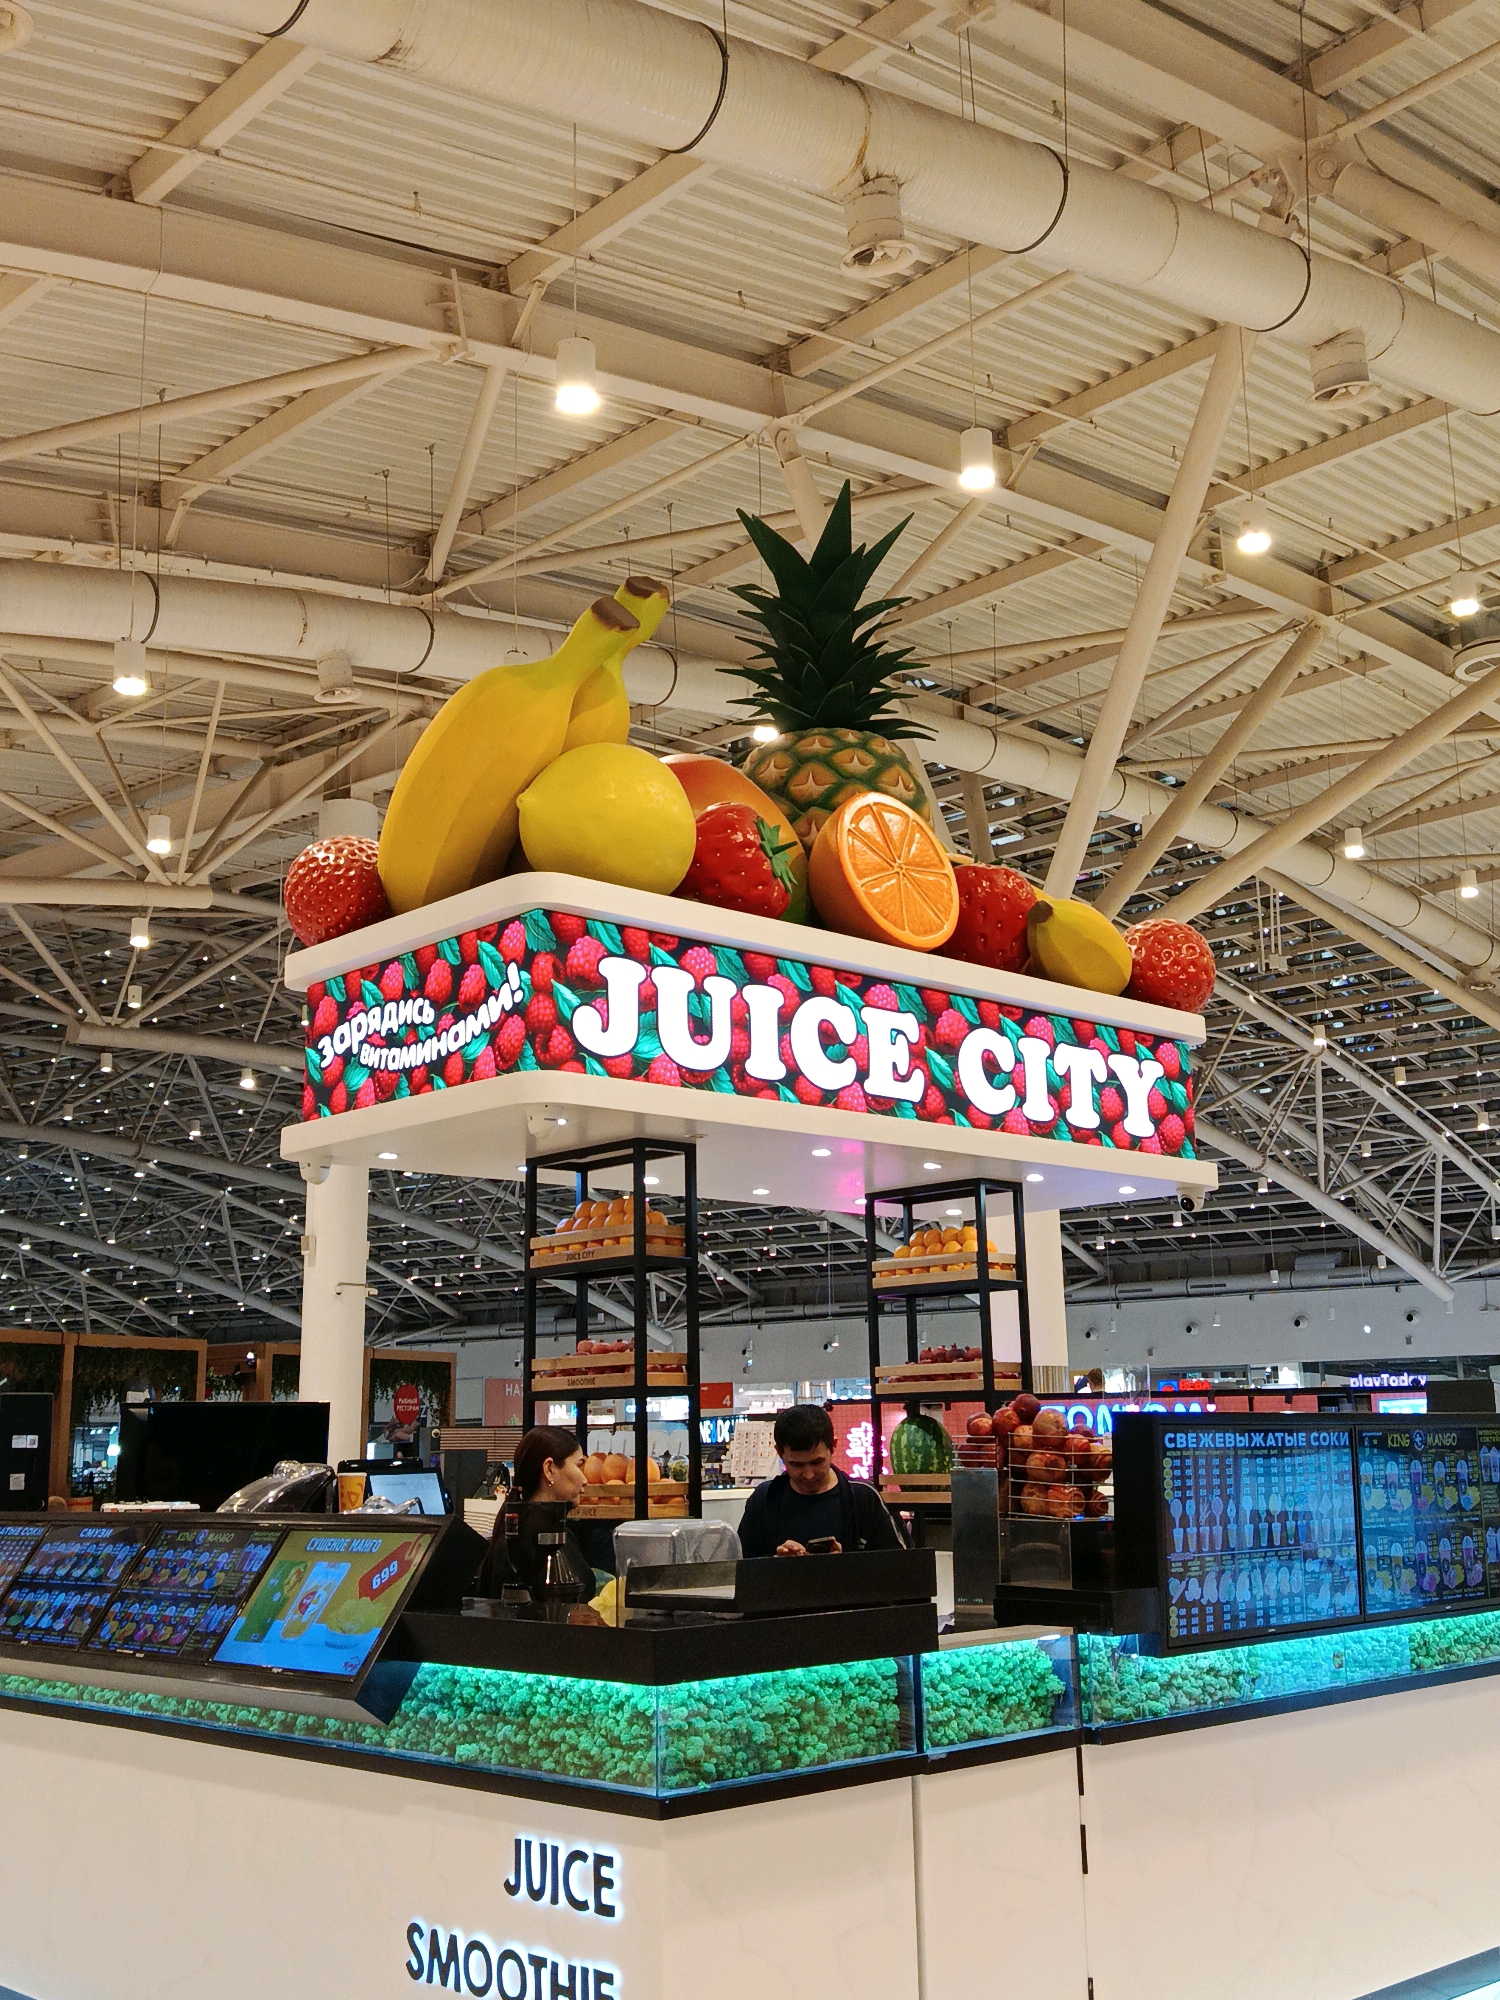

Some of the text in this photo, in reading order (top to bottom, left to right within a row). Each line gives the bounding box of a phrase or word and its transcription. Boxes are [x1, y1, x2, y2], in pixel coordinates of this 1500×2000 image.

[359, 961, 524, 1071] витаминами!
[573, 956, 1164, 1138] JUICE CITY
[566, 1250, 595, 1261] JUICE CITY
[567, 1377, 596, 1386] SMOOTHIE
[722, 1395, 731, 1406] 4
[1164, 1431, 1350, 1448] СВЕЖЕВЫЖАТЫЕ СОКИ
[80, 1528, 114, 1538] СМУЗИ
[348, 1538, 383, 1553] МАНГО
[371, 1560, 398, 1589] 699
[503, 1838, 616, 1918] JUICE
